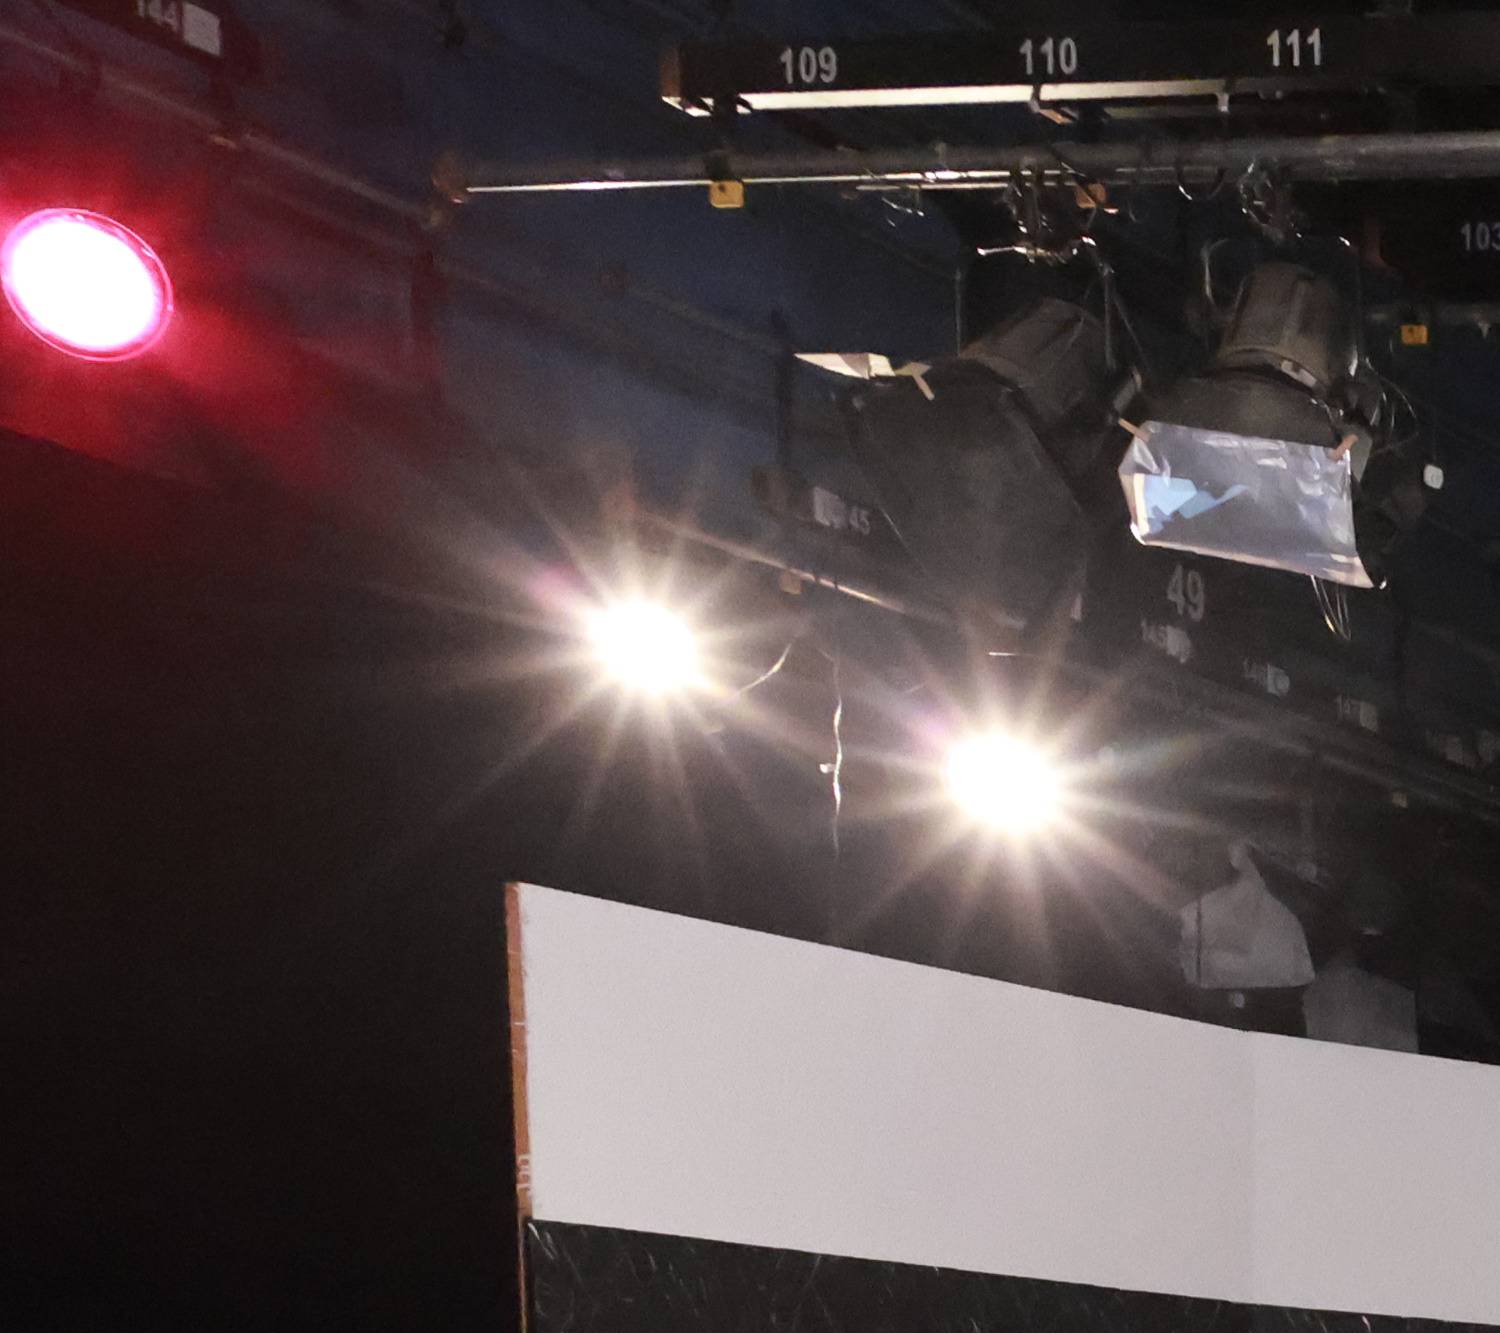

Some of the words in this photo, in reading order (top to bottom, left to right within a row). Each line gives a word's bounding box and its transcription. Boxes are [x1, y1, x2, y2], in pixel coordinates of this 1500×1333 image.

[780, 46, 838, 85] 109
[1019, 37, 1078, 75] 110
[1266, 27, 1321, 67] 111
[1167, 565, 1205, 621] 49
